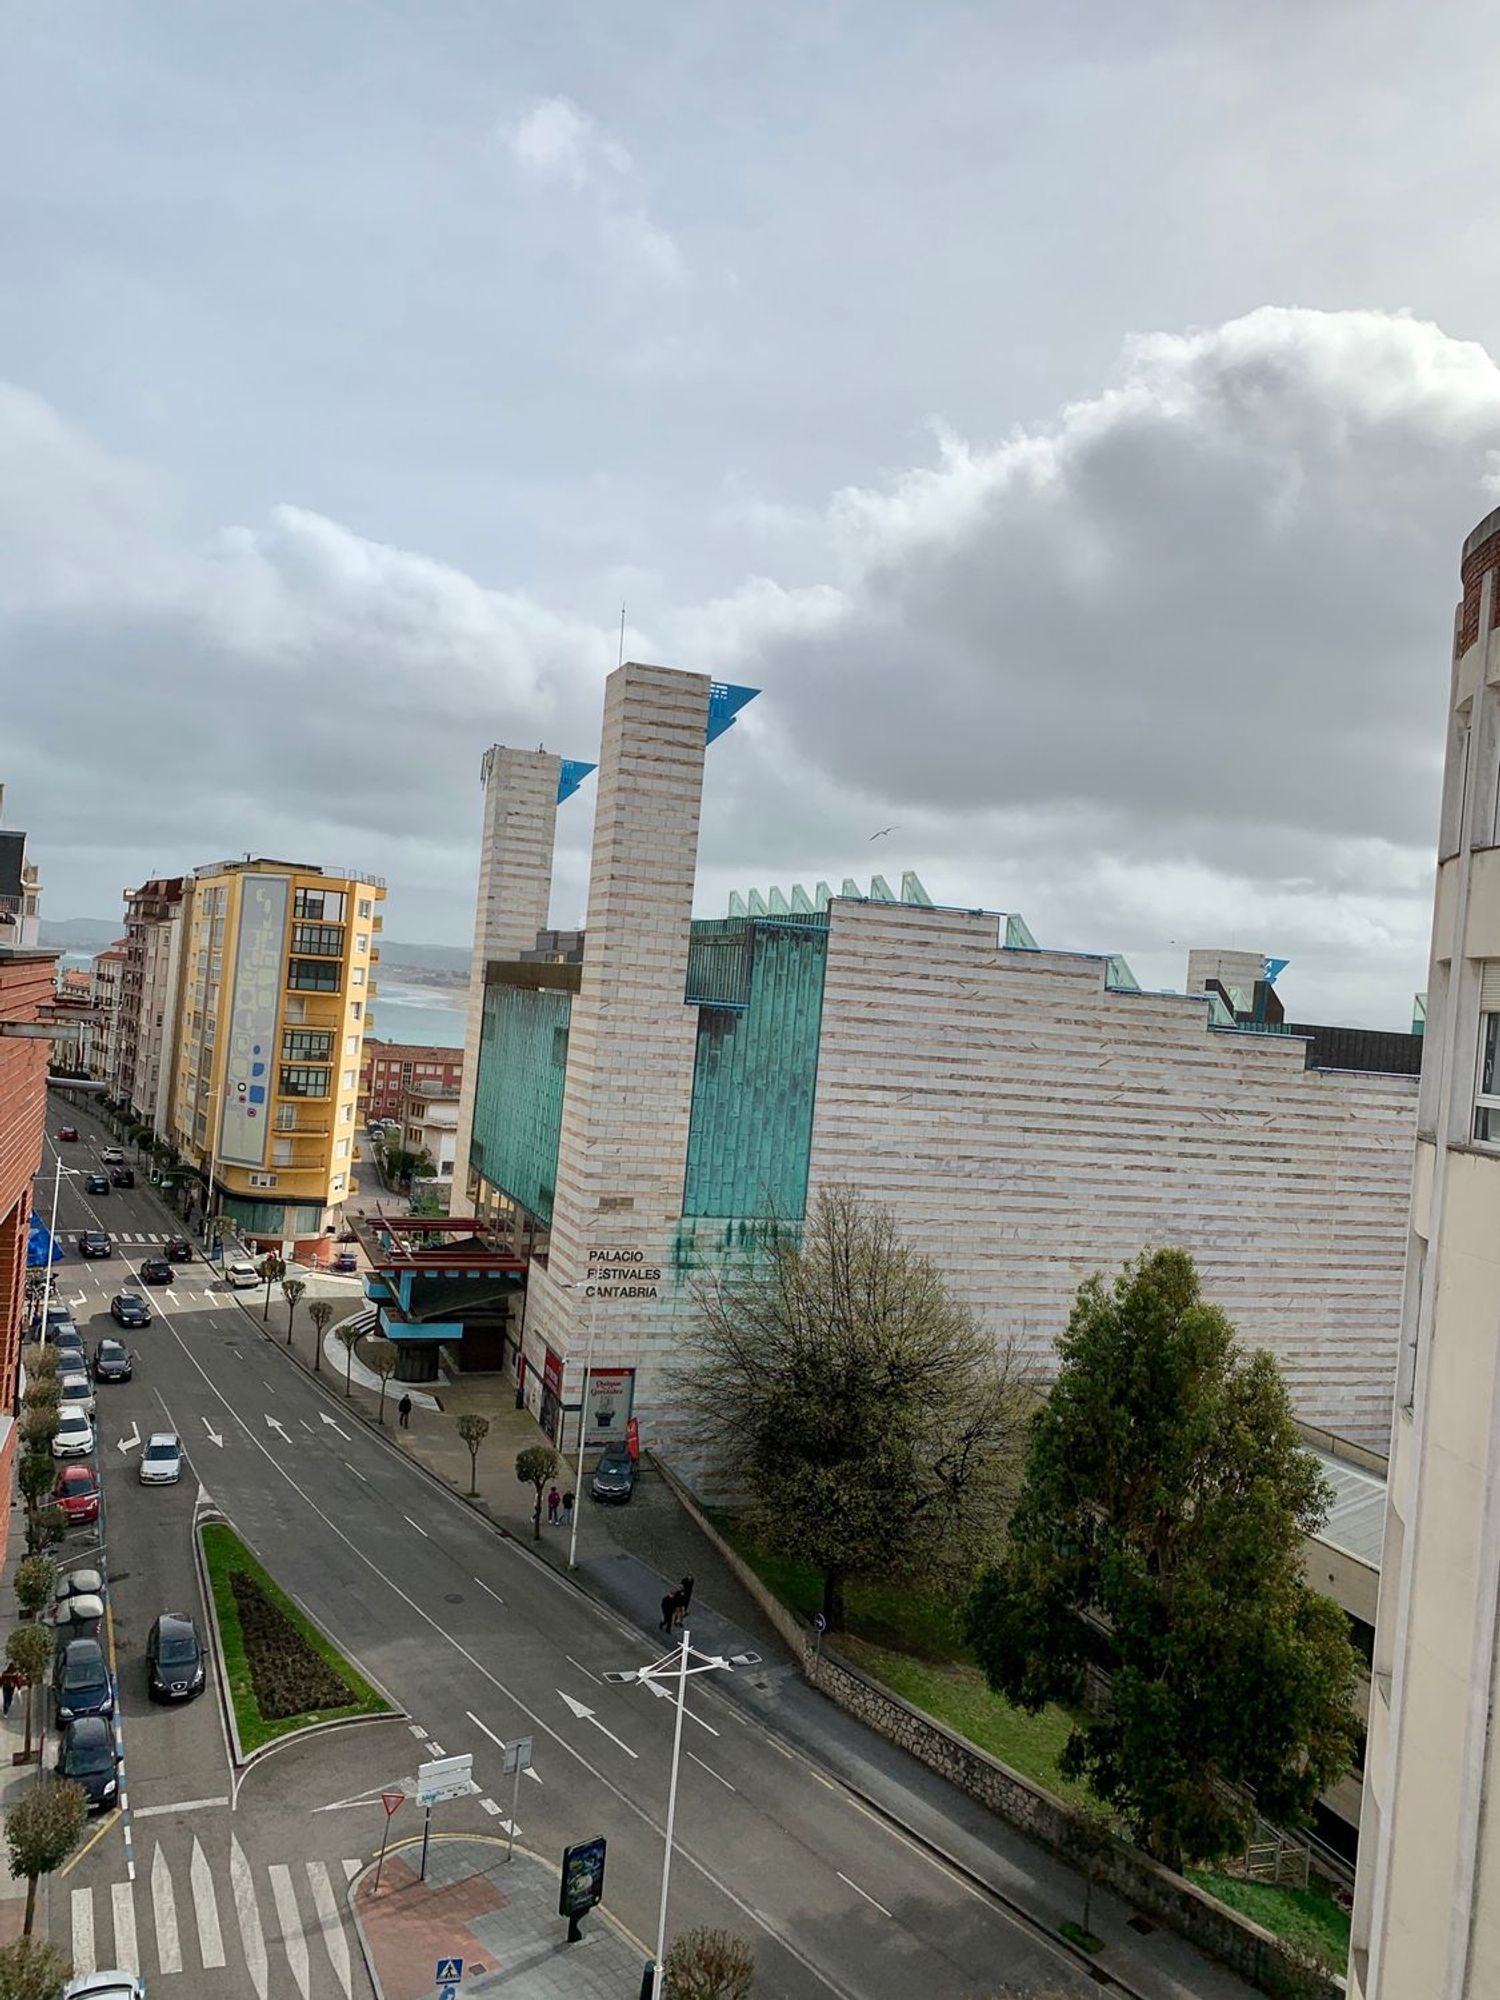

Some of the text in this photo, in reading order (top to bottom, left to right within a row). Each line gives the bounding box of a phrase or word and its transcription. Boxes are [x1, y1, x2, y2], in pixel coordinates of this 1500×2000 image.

[589, 1251, 643, 1262] PALACIO
[587, 1268, 661, 1280] FESTIVALES
[586, 1286, 657, 1298] CANTABRIA
